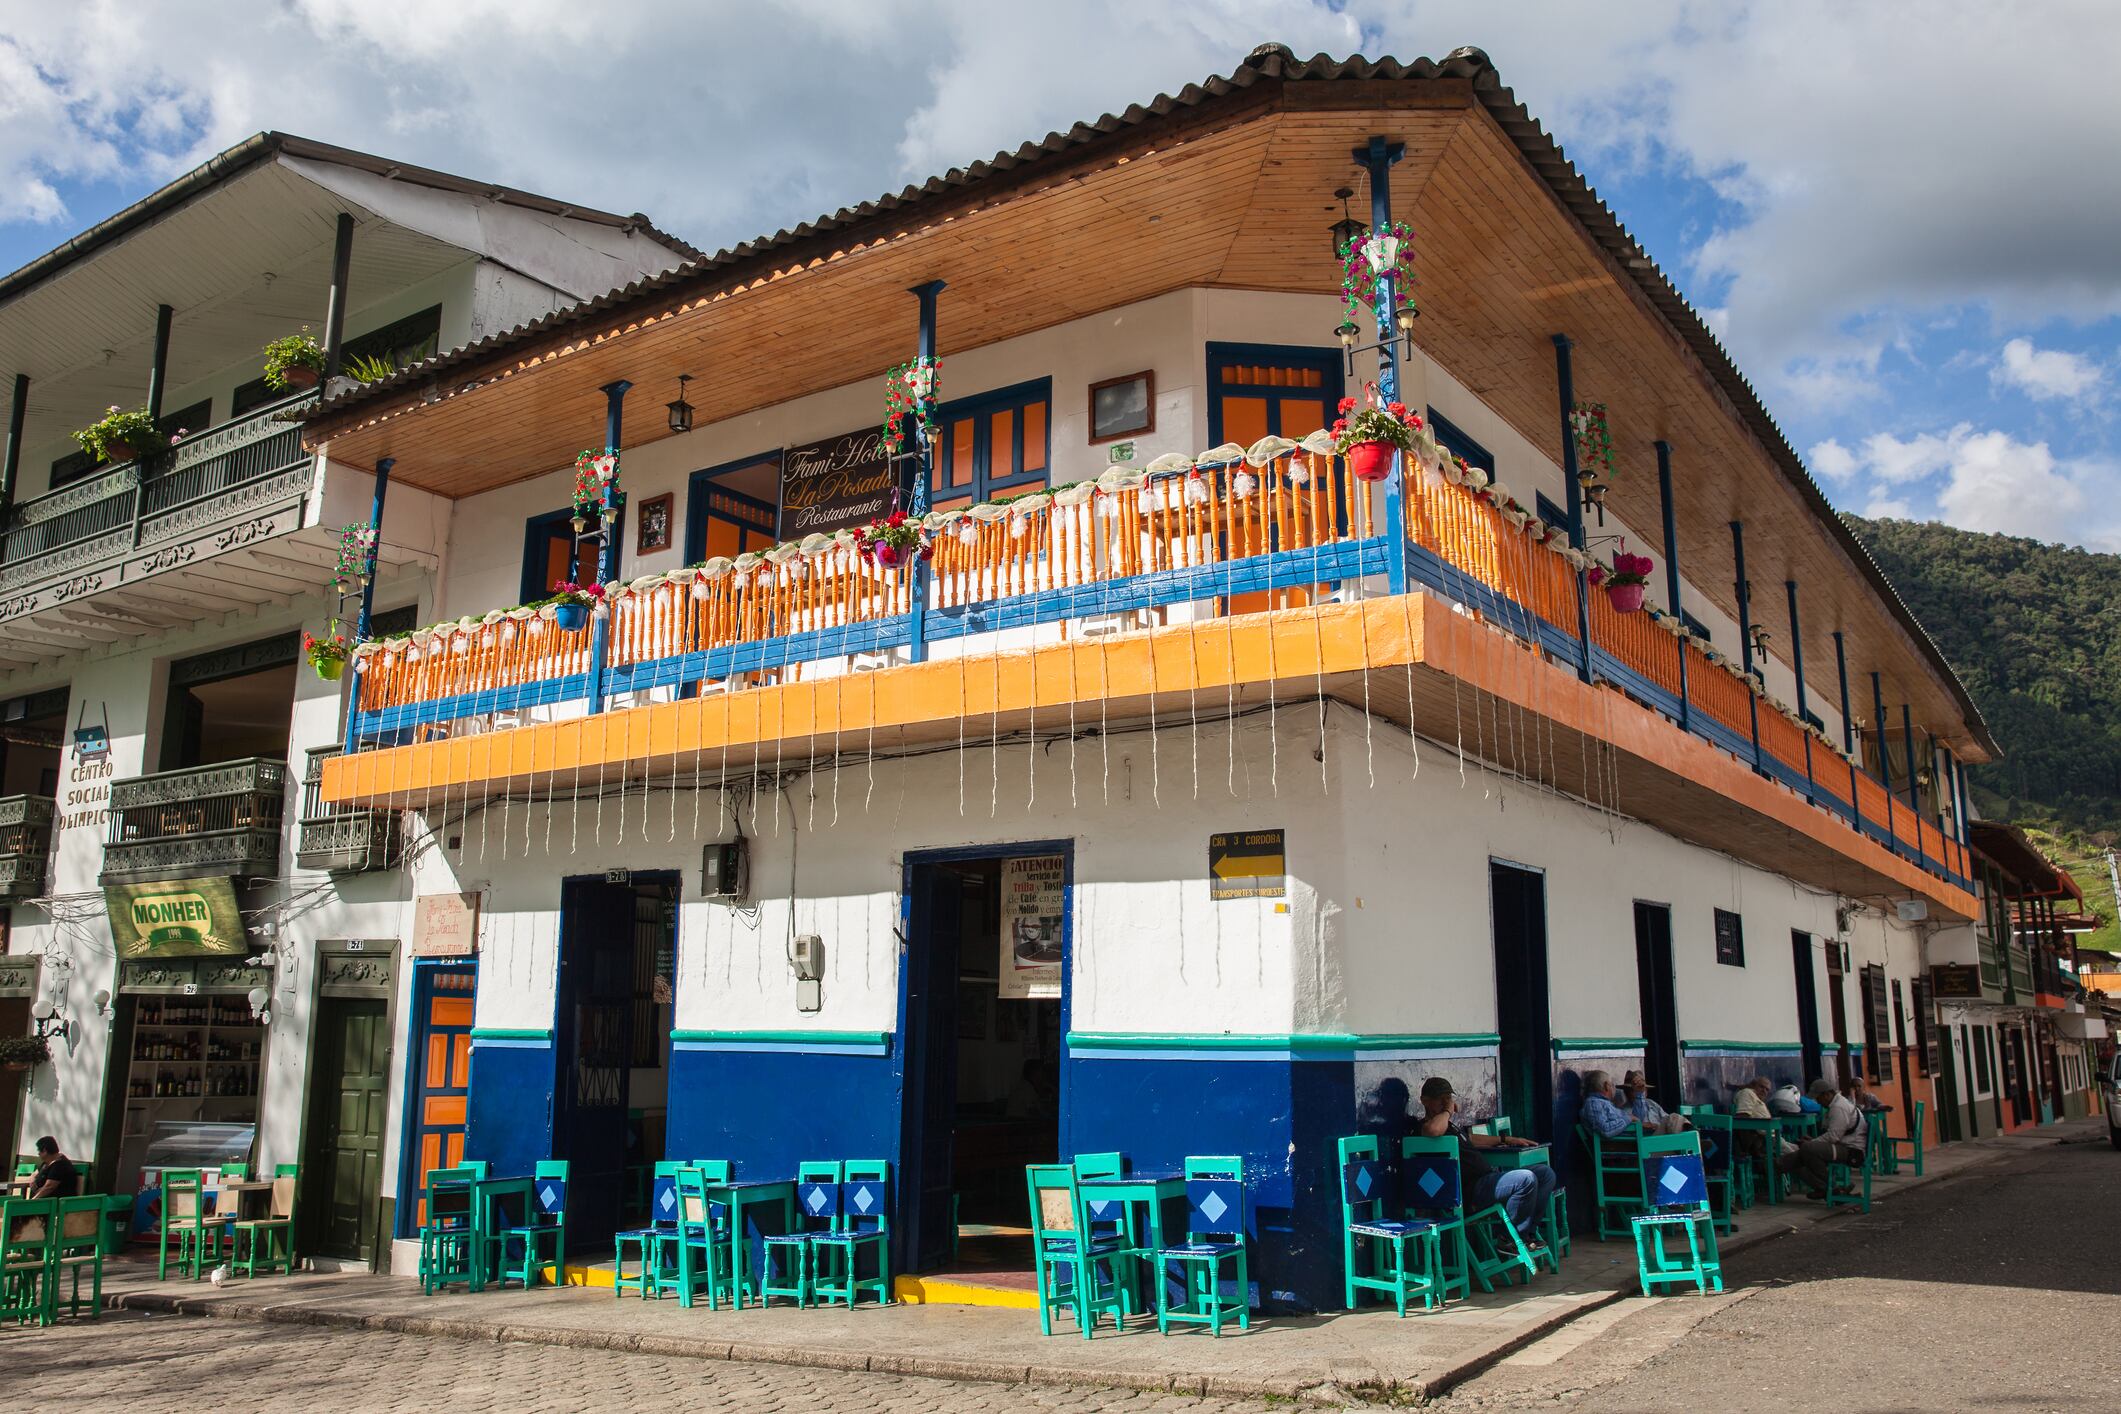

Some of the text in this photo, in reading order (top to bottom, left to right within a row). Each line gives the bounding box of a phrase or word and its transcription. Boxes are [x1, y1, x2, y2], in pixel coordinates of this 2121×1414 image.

[783, 433, 890, 482] Fami Hote
[783, 479, 818, 511] La
[795, 499, 882, 528] Restaurante
[71, 762, 113, 782] CENTRO
[67, 785, 109, 806] SOCIAL
[1234, 836, 1239, 845] 3
[1245, 834, 1281, 845] CORDOBA
[1011, 854, 1063, 873] ¡ATENCIÓ
[1027, 871, 1060, 881] Servicio de
[1212, 888, 1253, 899] TRANSPORTES
[134, 901, 207, 924] MONHER
